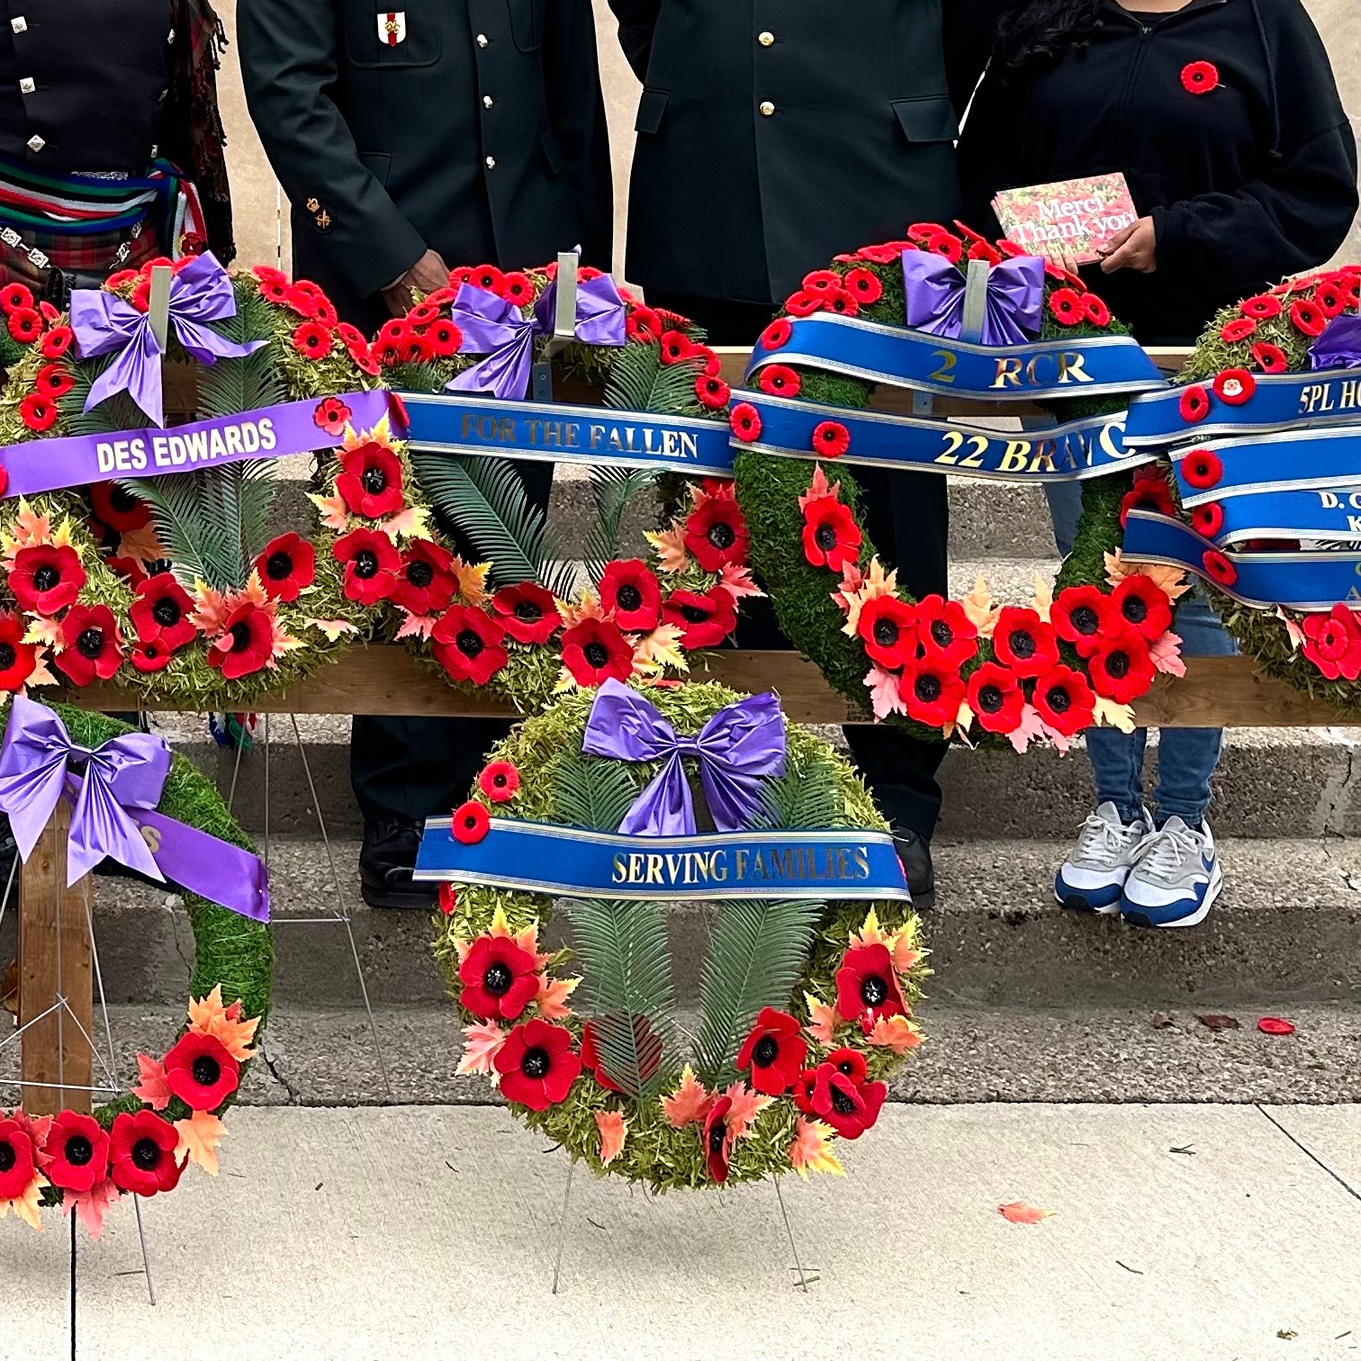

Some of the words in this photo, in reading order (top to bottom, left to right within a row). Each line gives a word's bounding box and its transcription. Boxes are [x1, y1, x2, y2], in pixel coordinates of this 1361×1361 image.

[1036, 195, 1105, 220] Merci
[1010, 213, 1090, 243] Thank
[1095, 210, 1135, 238] you
[928, 350, 957, 383] 2
[988, 352, 1095, 388] RCR
[1338, 380, 1361, 409] H
[97, 441, 148, 473] DES
[154, 418, 276, 467] EDWARDS
[460, 413, 517, 440] FOR
[524, 418, 580, 449] THE
[590, 424, 699, 459] FALLEN
[934, 431, 988, 468] 22
[611, 850, 727, 884] SERVING
[735, 846, 870, 880] FAMILIES
